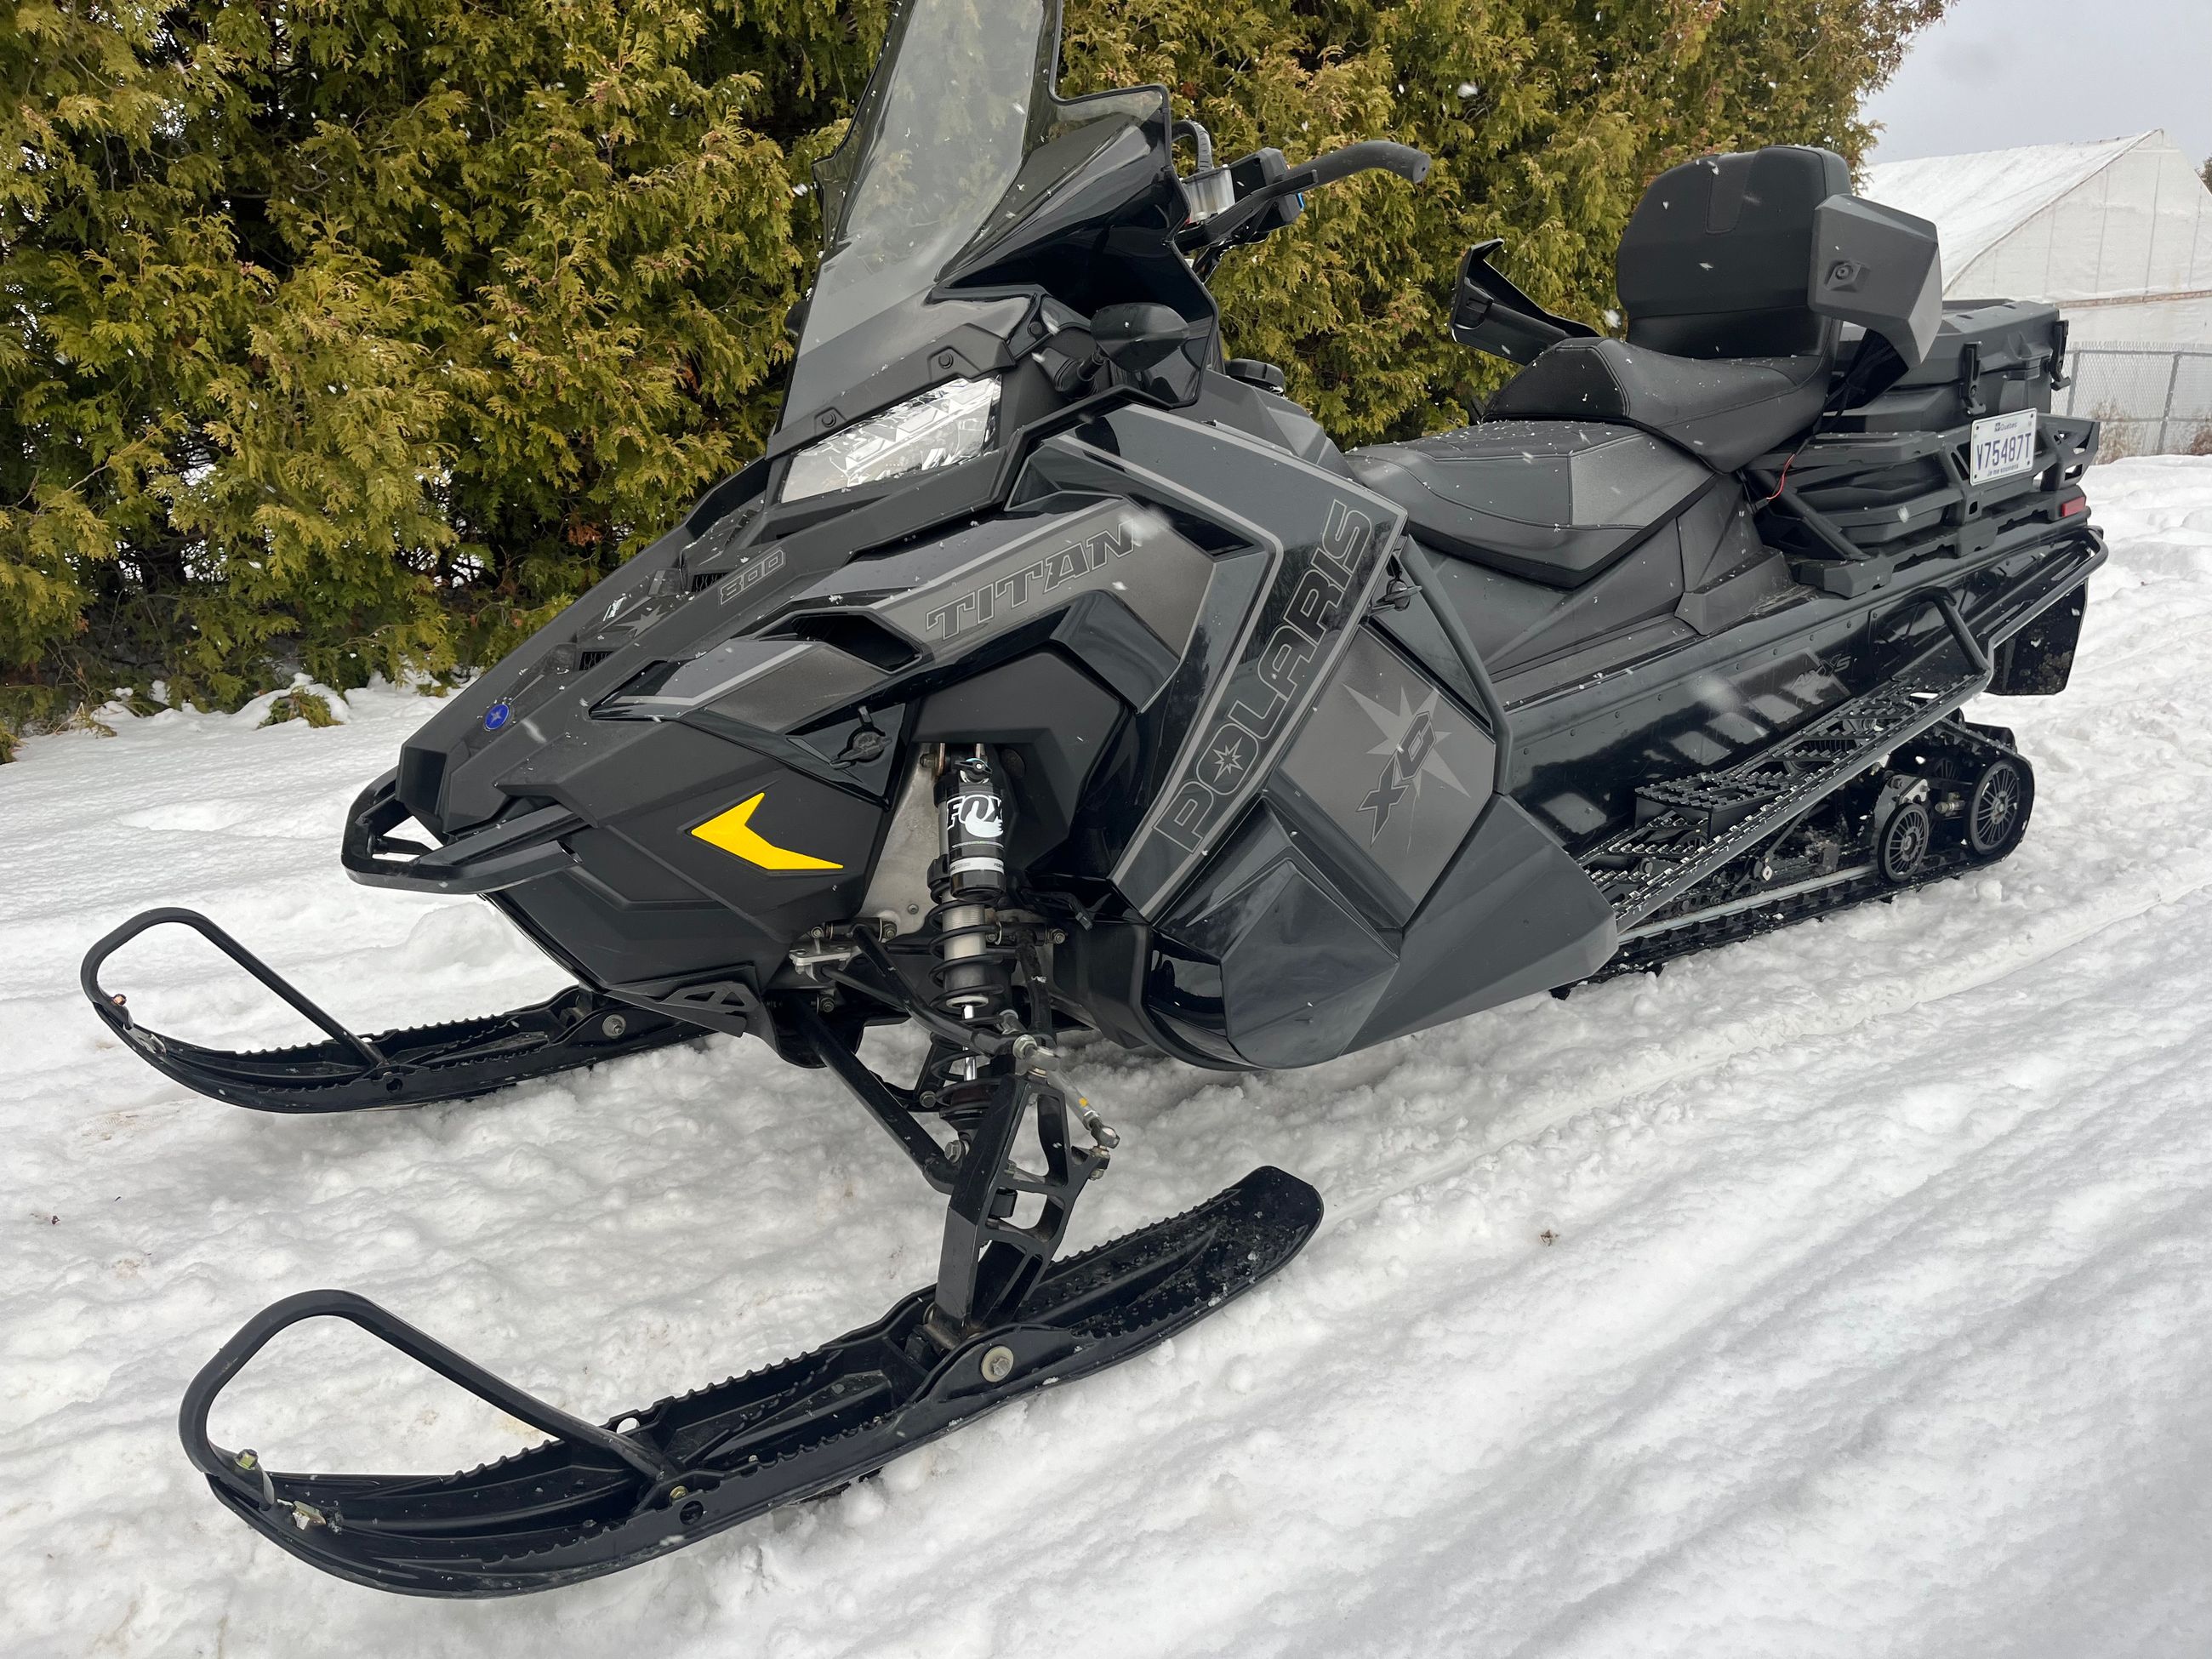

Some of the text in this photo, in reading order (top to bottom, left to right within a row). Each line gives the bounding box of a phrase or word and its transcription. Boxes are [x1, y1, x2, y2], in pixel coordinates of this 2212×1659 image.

[1976, 432, 2032, 470] V75487T
[719, 548, 784, 606] 800
[925, 517, 1136, 641] TITAN
[1152, 499, 1372, 854] POLARIS
[947, 794, 1004, 838] FOX
